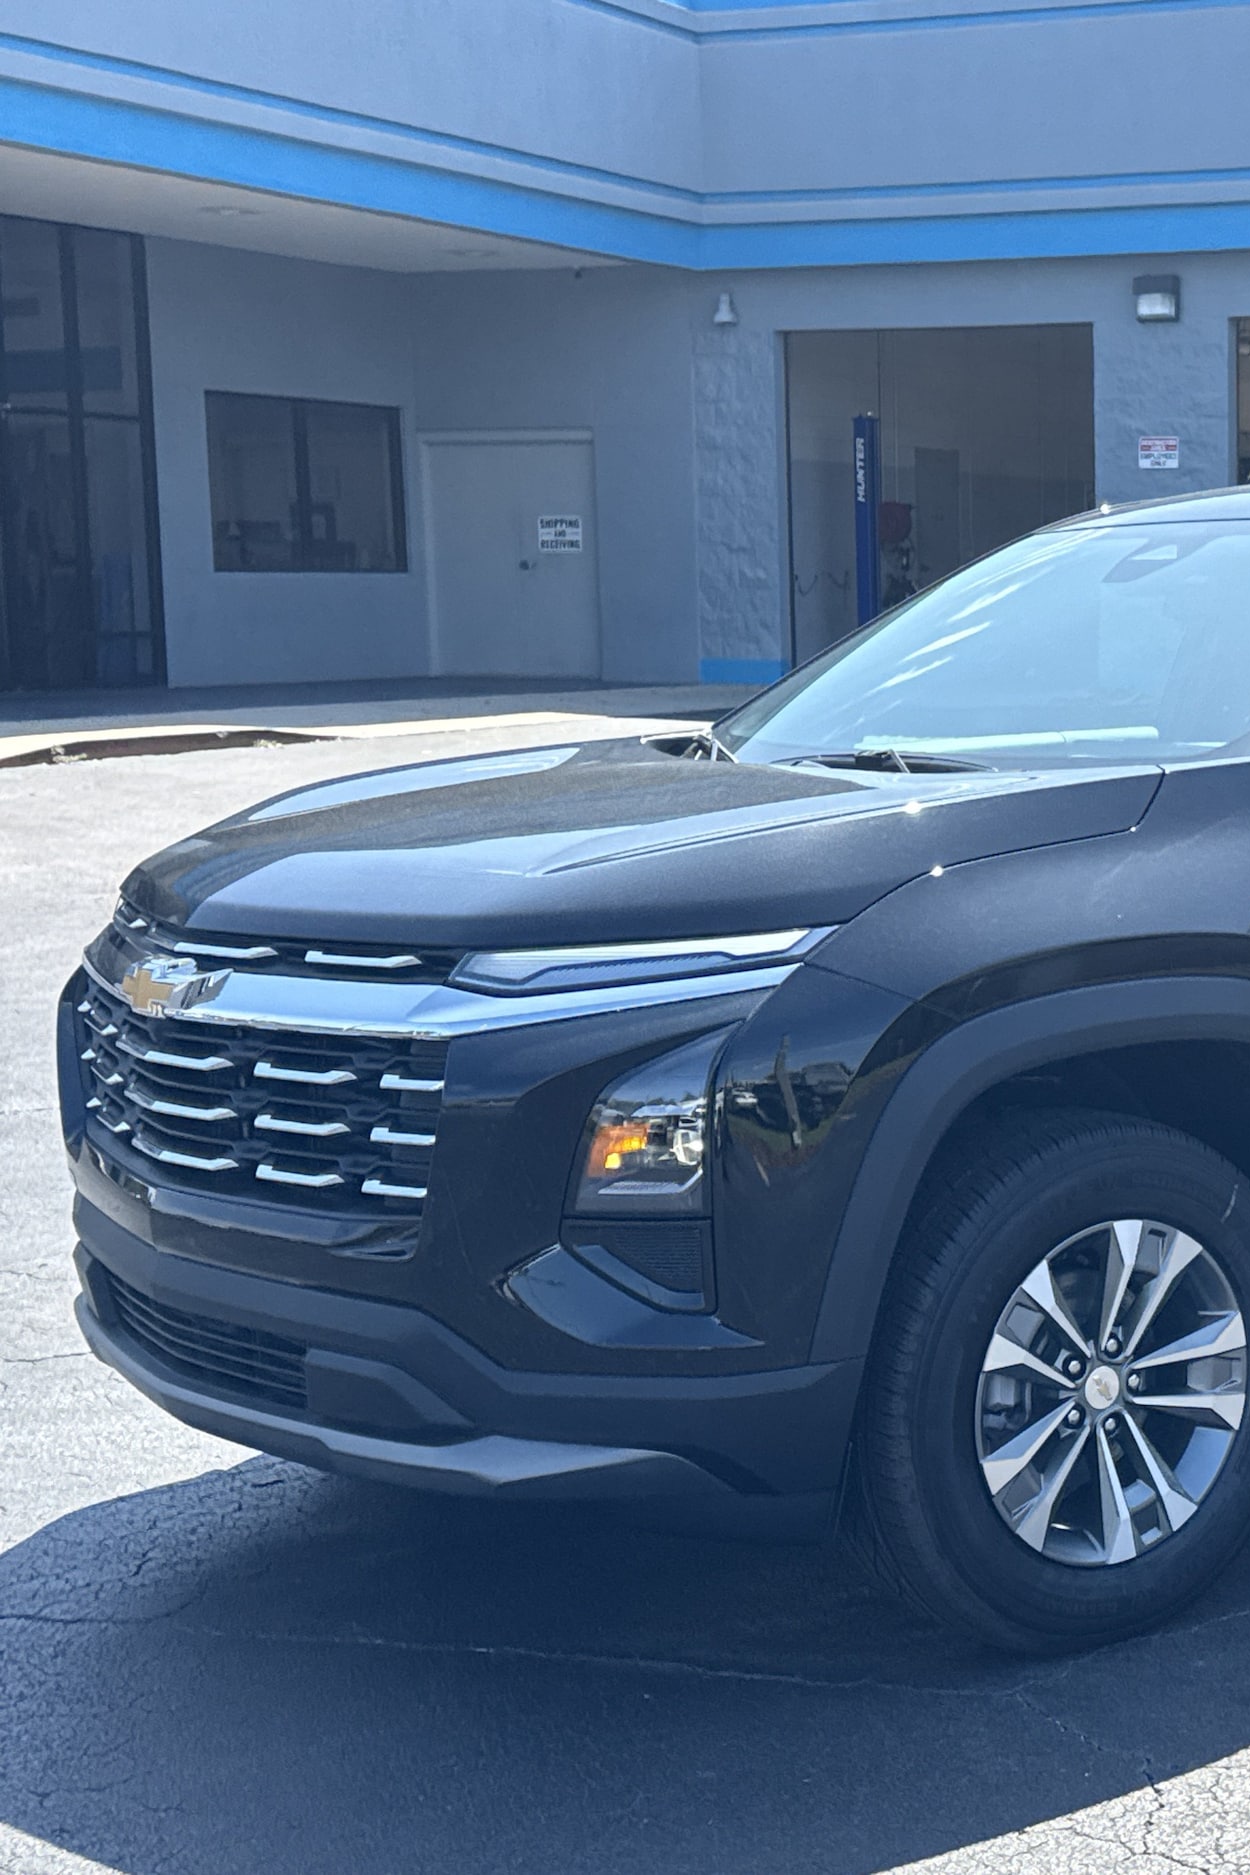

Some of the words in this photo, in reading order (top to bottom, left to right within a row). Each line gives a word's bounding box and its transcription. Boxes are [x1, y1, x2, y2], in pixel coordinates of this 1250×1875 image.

[855, 437, 866, 503] HUNTER
[540, 518, 580, 529] SHIPPING
[554, 529, 567, 538] AND
[540, 539, 581, 550] RECEIVING
